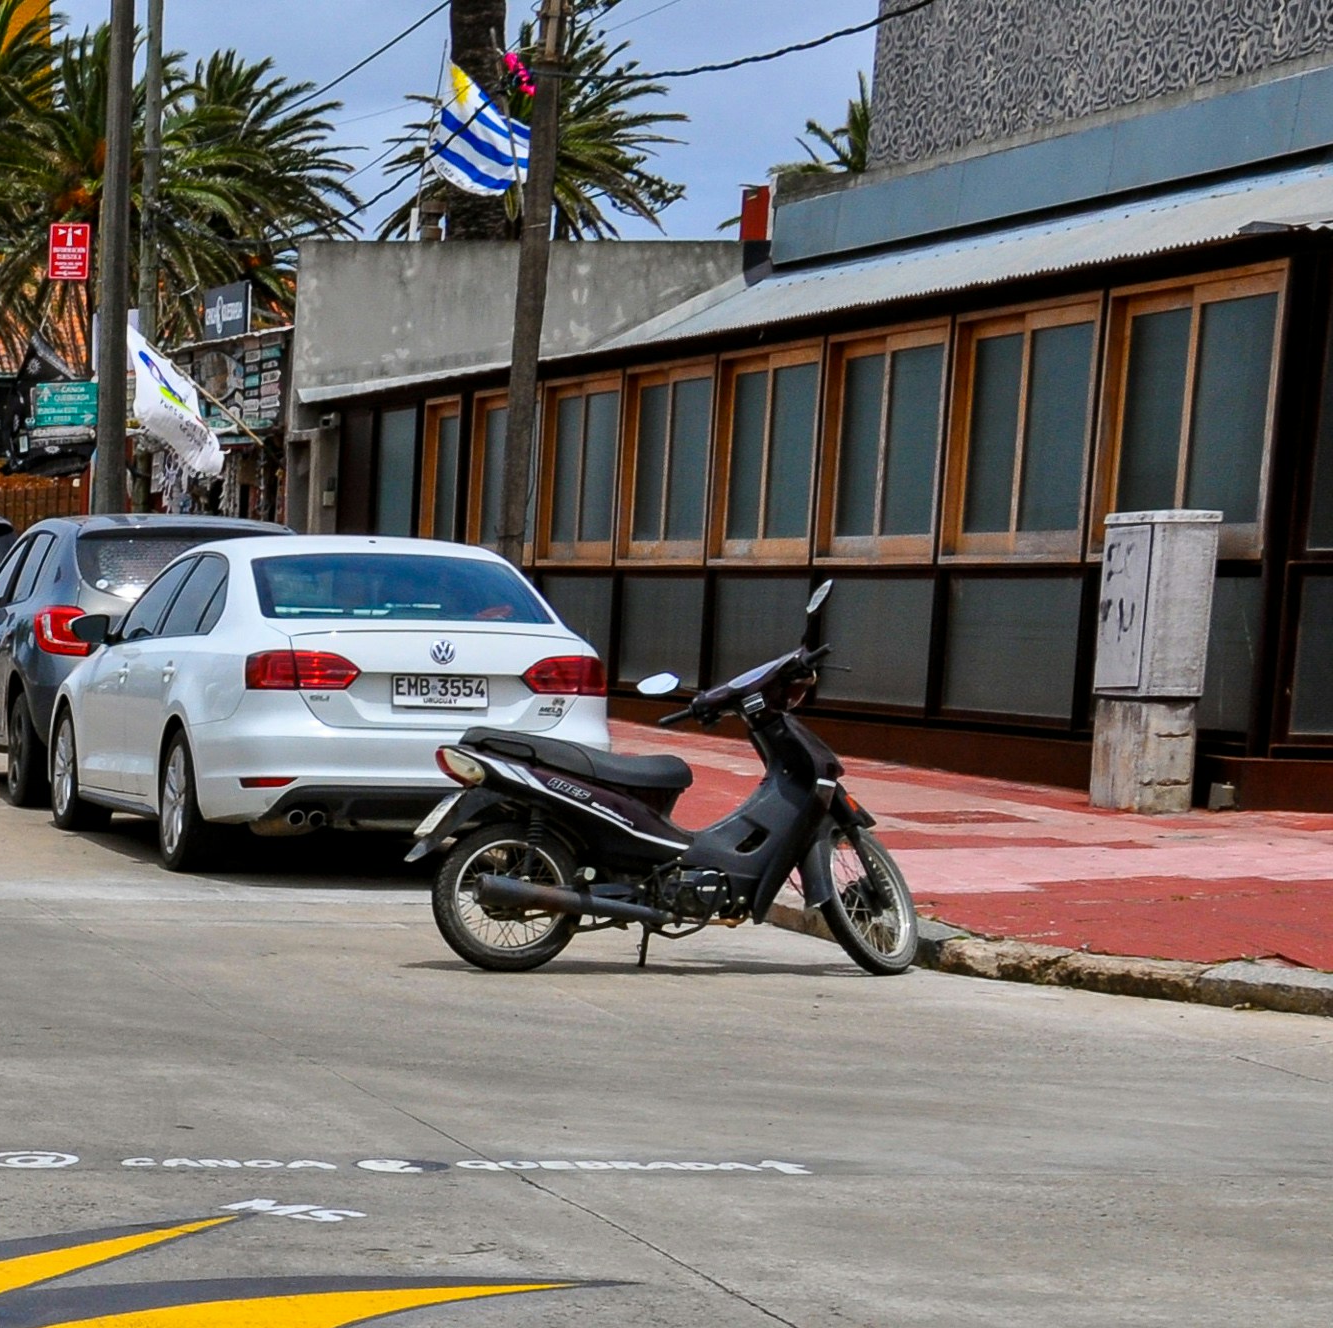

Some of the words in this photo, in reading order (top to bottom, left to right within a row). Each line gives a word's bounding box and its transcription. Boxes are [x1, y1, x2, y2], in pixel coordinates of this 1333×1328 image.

[395, 677, 431, 696] EMB
[438, 678, 486, 698] 3554
[423, 697, 458, 705] URUGUAY
